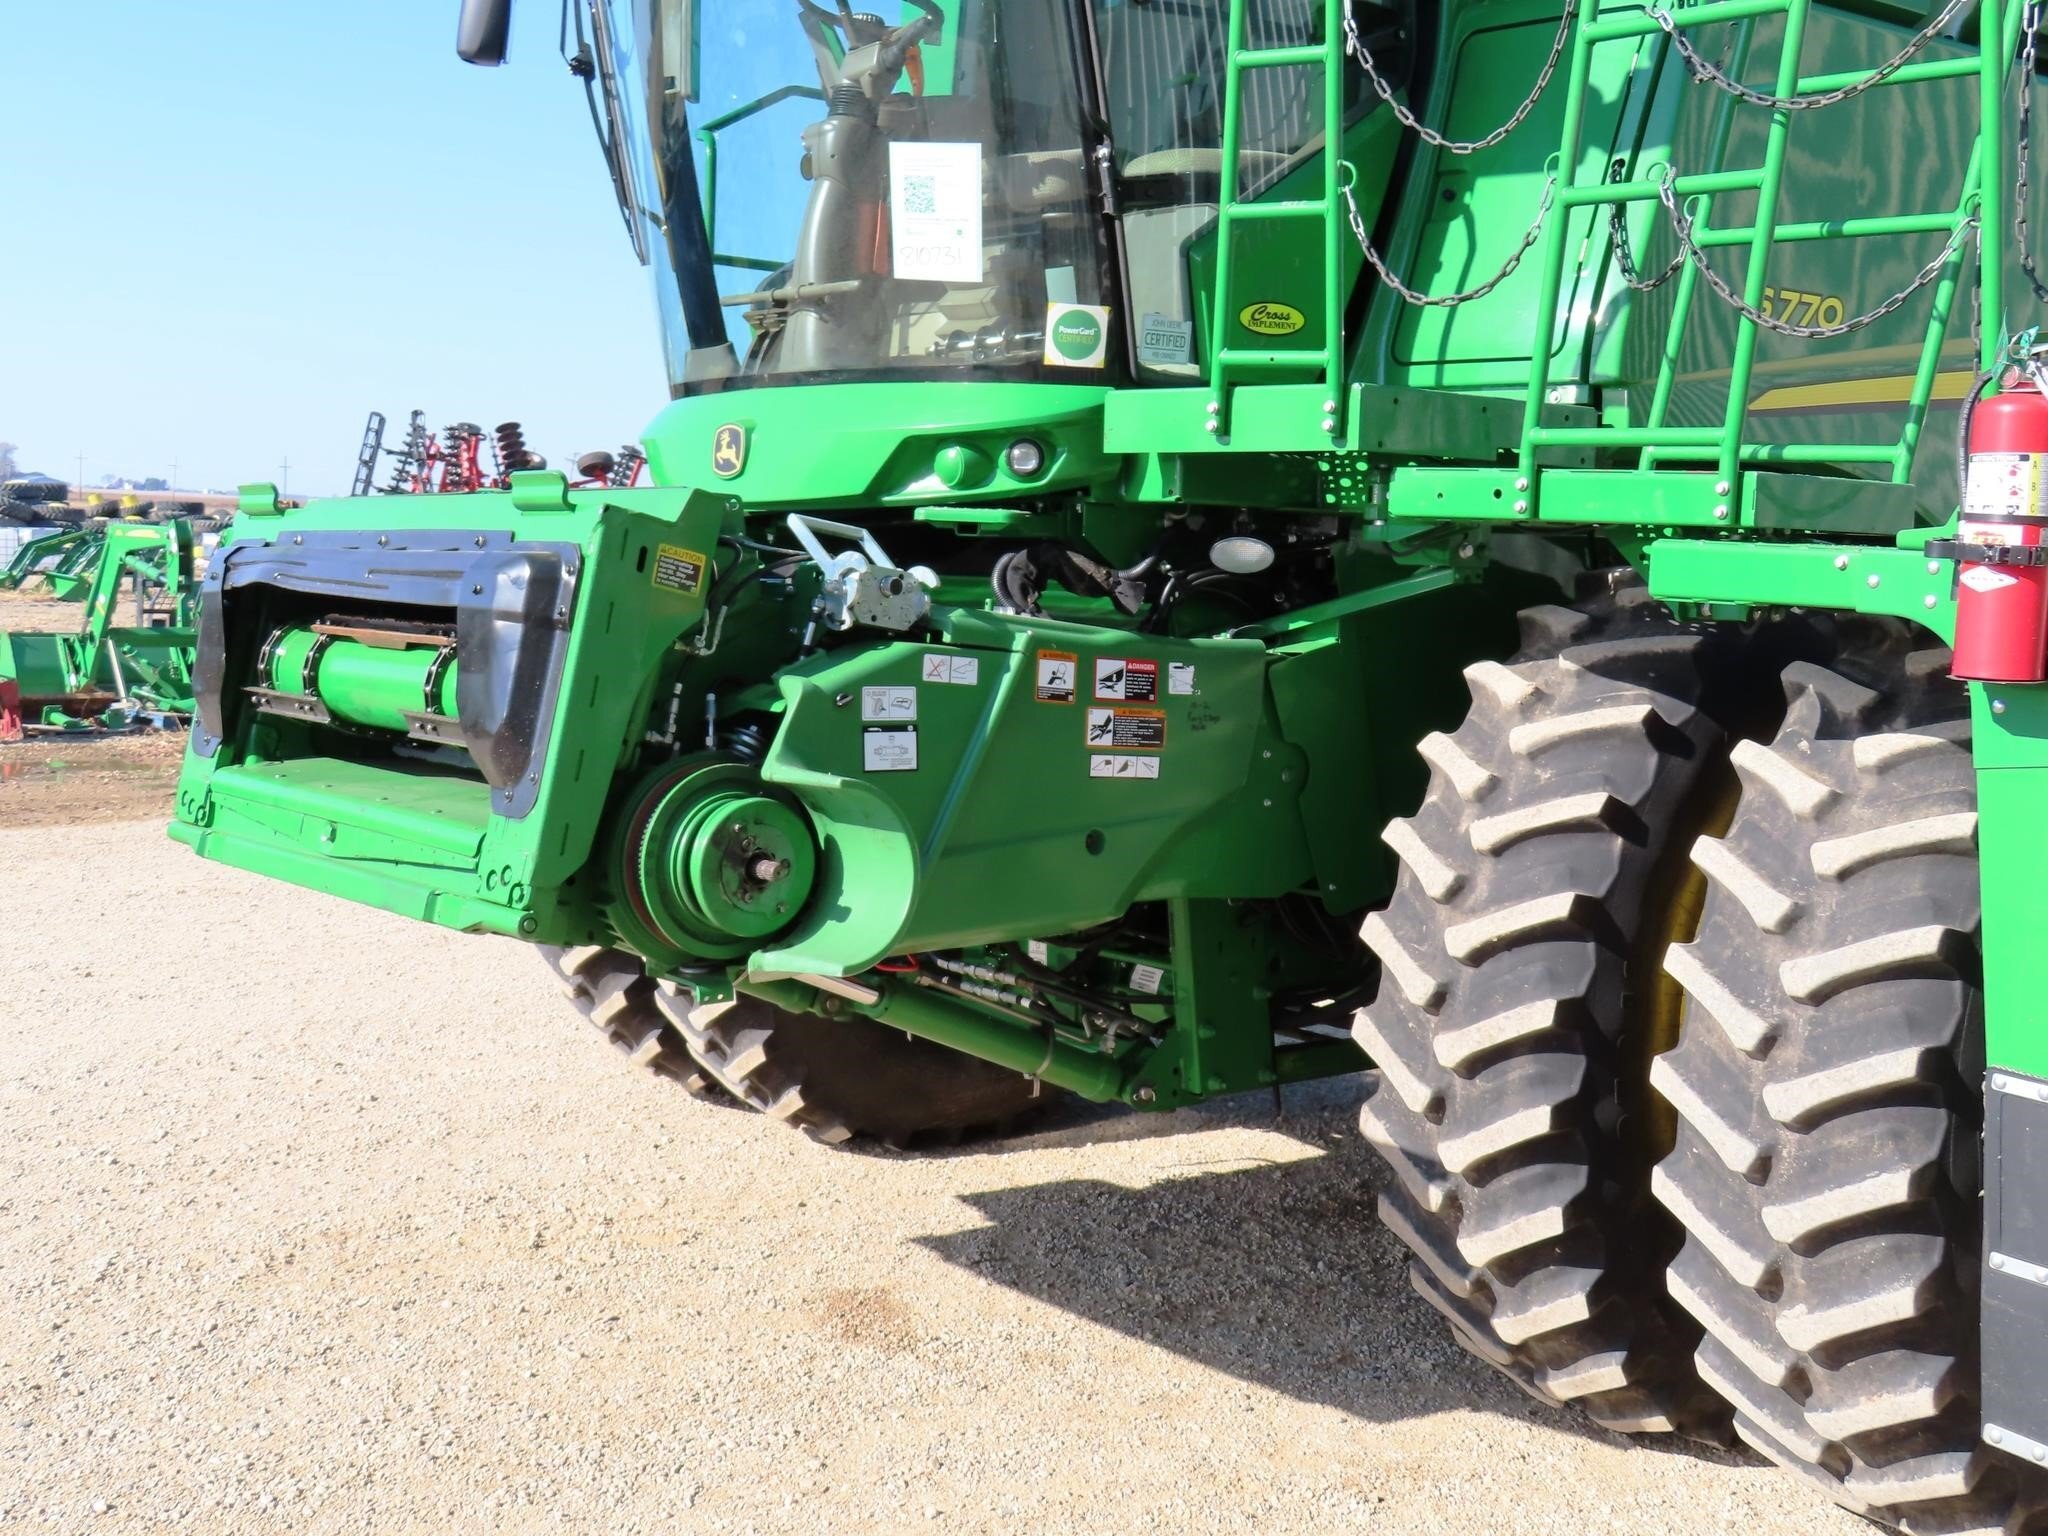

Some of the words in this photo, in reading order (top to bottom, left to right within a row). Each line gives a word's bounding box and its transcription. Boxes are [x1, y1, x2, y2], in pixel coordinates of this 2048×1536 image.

[1251, 305, 1290, 321] Cross
[1248, 320, 1297, 330] IMPLEMENT
[1144, 331, 1186, 349] CERTIFIED
[668, 547, 704, 563] CAUTION
